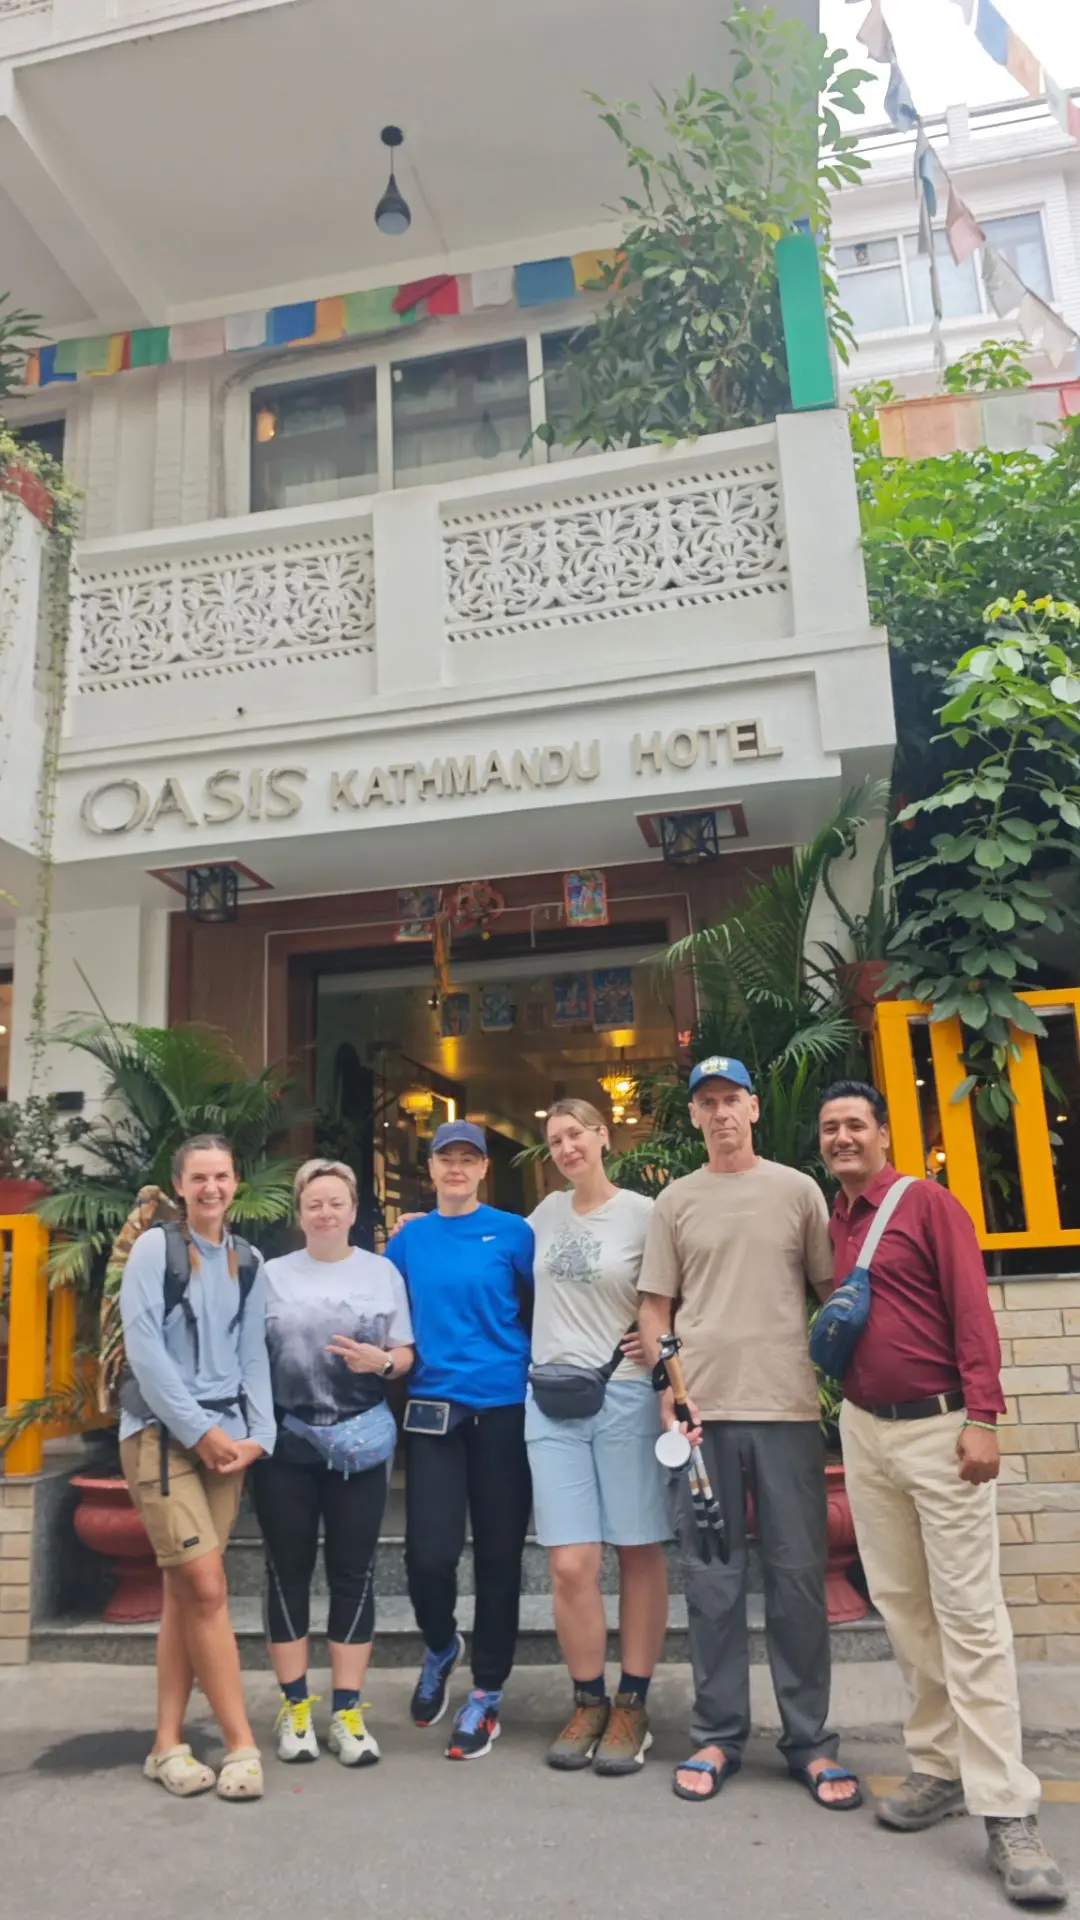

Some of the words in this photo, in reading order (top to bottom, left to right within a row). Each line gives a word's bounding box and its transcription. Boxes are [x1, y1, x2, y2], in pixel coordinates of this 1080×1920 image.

[81, 768, 307, 836] OASIS
[331, 738, 600, 811] KATHMANDU
[632, 717, 784, 775] HOTEL
